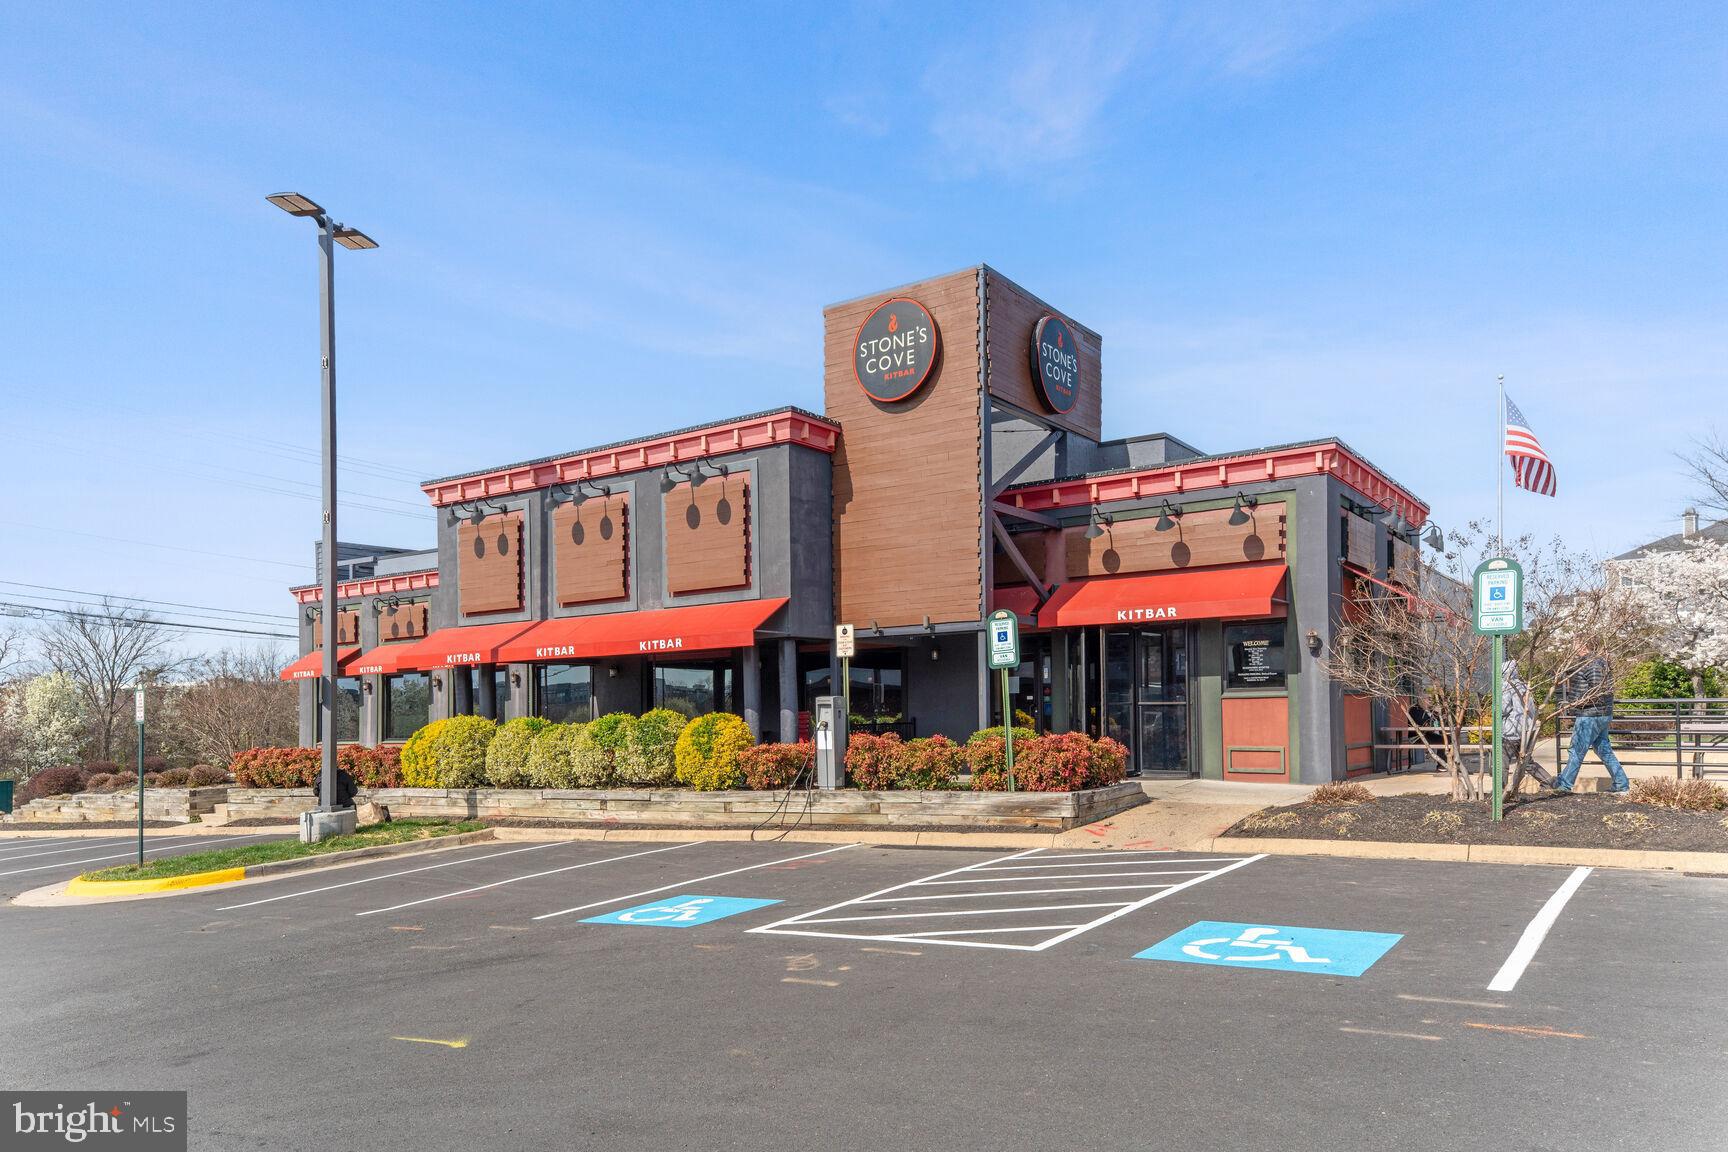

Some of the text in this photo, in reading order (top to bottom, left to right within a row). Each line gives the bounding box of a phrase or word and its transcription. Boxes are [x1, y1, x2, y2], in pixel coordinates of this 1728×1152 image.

[860, 326, 927, 358] STONE'S
[866, 349, 915, 374] COVE
[1042, 342, 1077, 373] STONE'S
[884, 367, 915, 381] KITBAR
[1046, 363, 1072, 387] COVE
[1117, 607, 1177, 620] KITBAR
[536, 645, 575, 657] KITBAR
[639, 638, 682, 651] KITBAR
[446, 652, 481, 663] KITBAR
[293, 670, 314, 679] KITBAR
[360, 665, 383, 674] KITBAR
